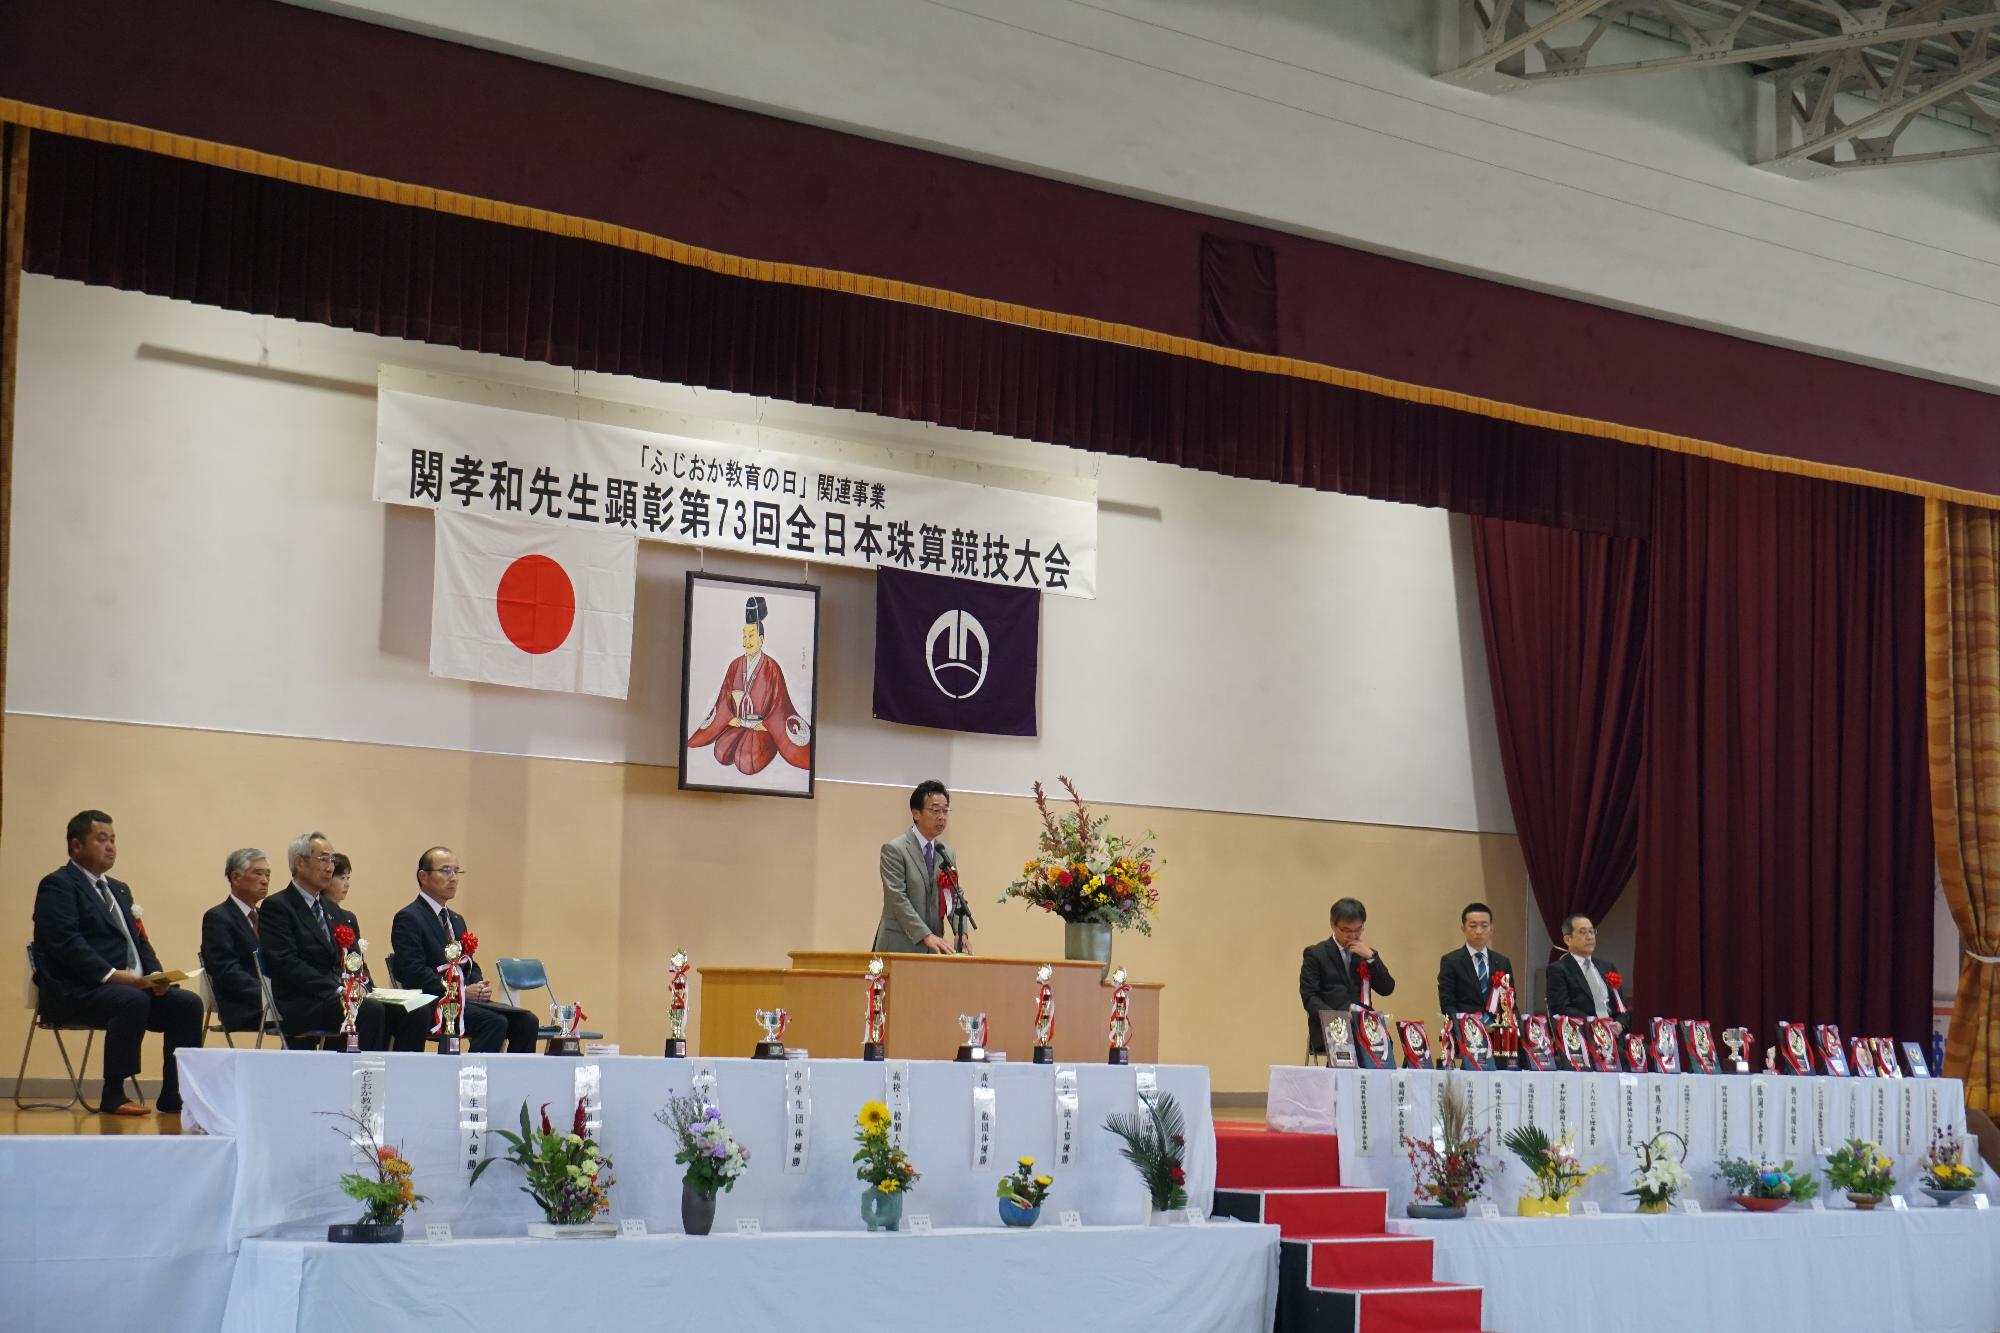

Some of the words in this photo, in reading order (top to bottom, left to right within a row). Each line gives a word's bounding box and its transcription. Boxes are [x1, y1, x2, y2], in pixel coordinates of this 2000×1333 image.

[409, 447, 1071, 590] 関孝和先生顕彰第73回全日本珠算競技大会
[641, 444, 886, 510] 「ふじおか教育の日」関連事業
[791, 1070, 803, 1167] 中学生団体優勝
